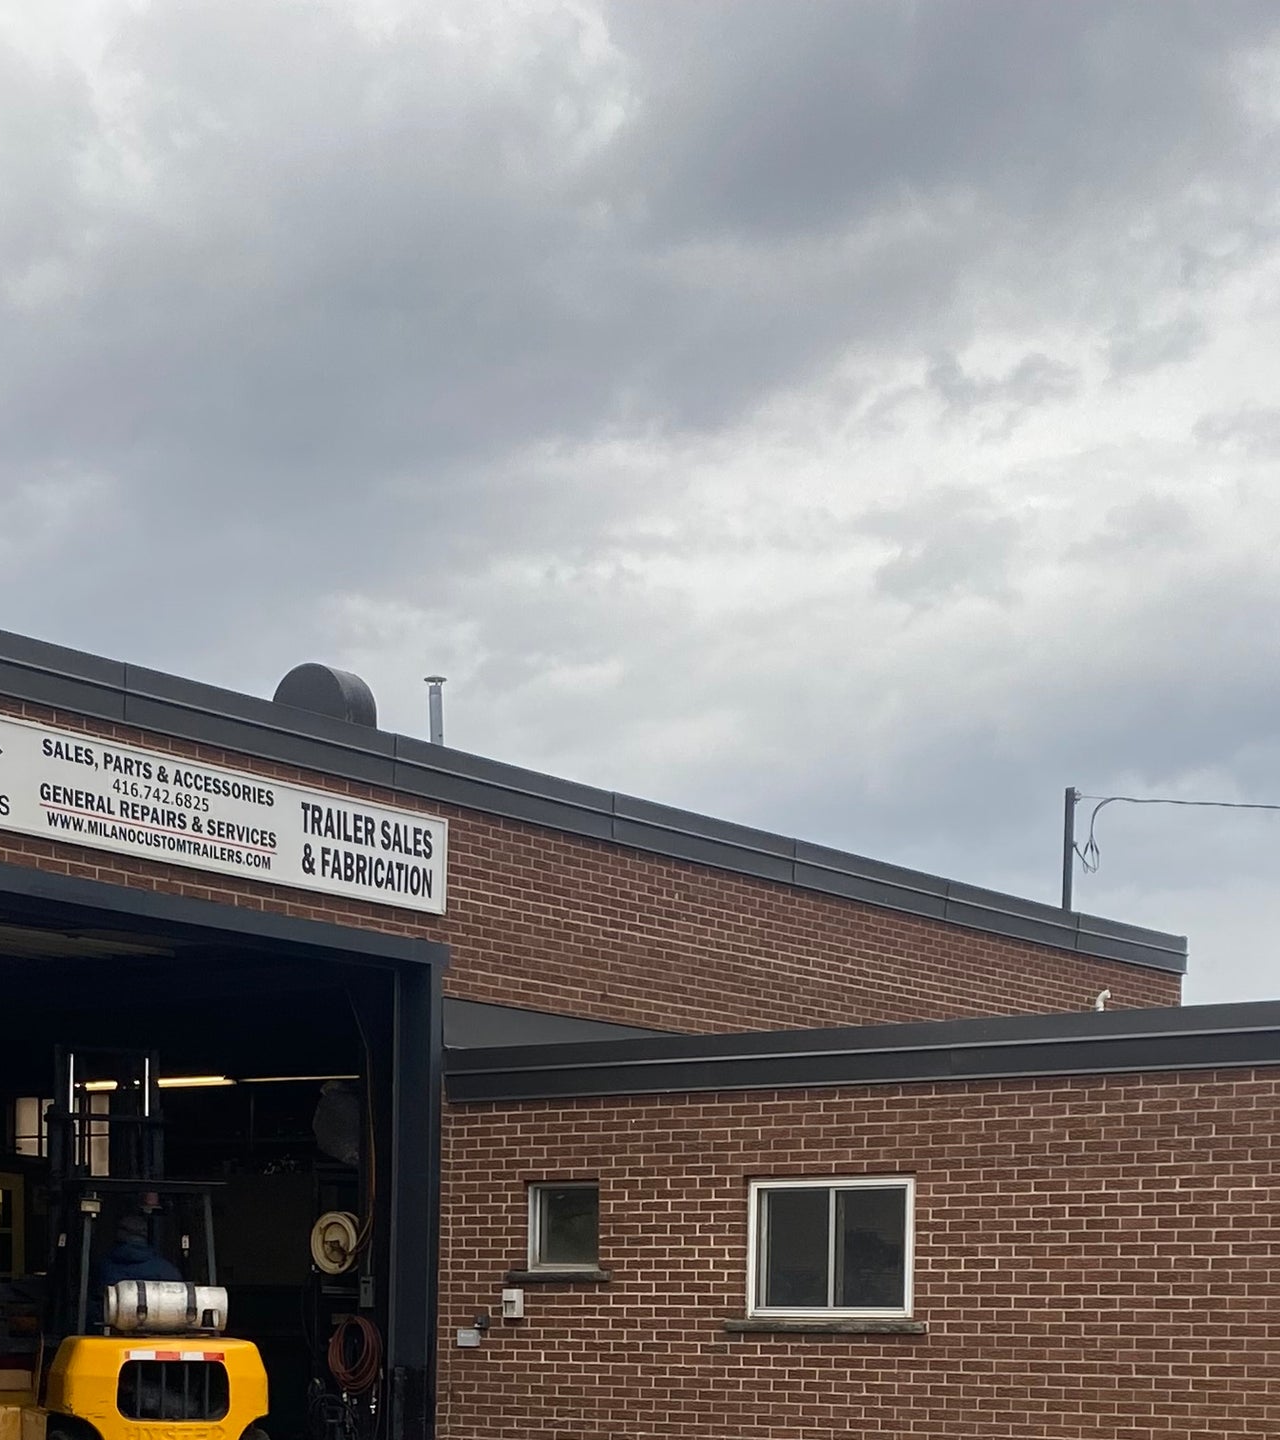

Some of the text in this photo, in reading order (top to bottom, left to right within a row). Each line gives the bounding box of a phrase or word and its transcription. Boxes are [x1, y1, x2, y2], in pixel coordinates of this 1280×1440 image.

[42, 738, 275, 807] SALES, PARTS & ACCESSORIES
[112, 778, 209, 812] 416.742.6825
[40, 783, 277, 848] GENERAL REPAIRS & SERVICES
[46, 811, 271, 870] WWW.MILANOCUSTOMTRAILERS.COM
[301, 801, 433, 859] TRAILER SALES
[302, 843, 433, 899] & FABRICATION
